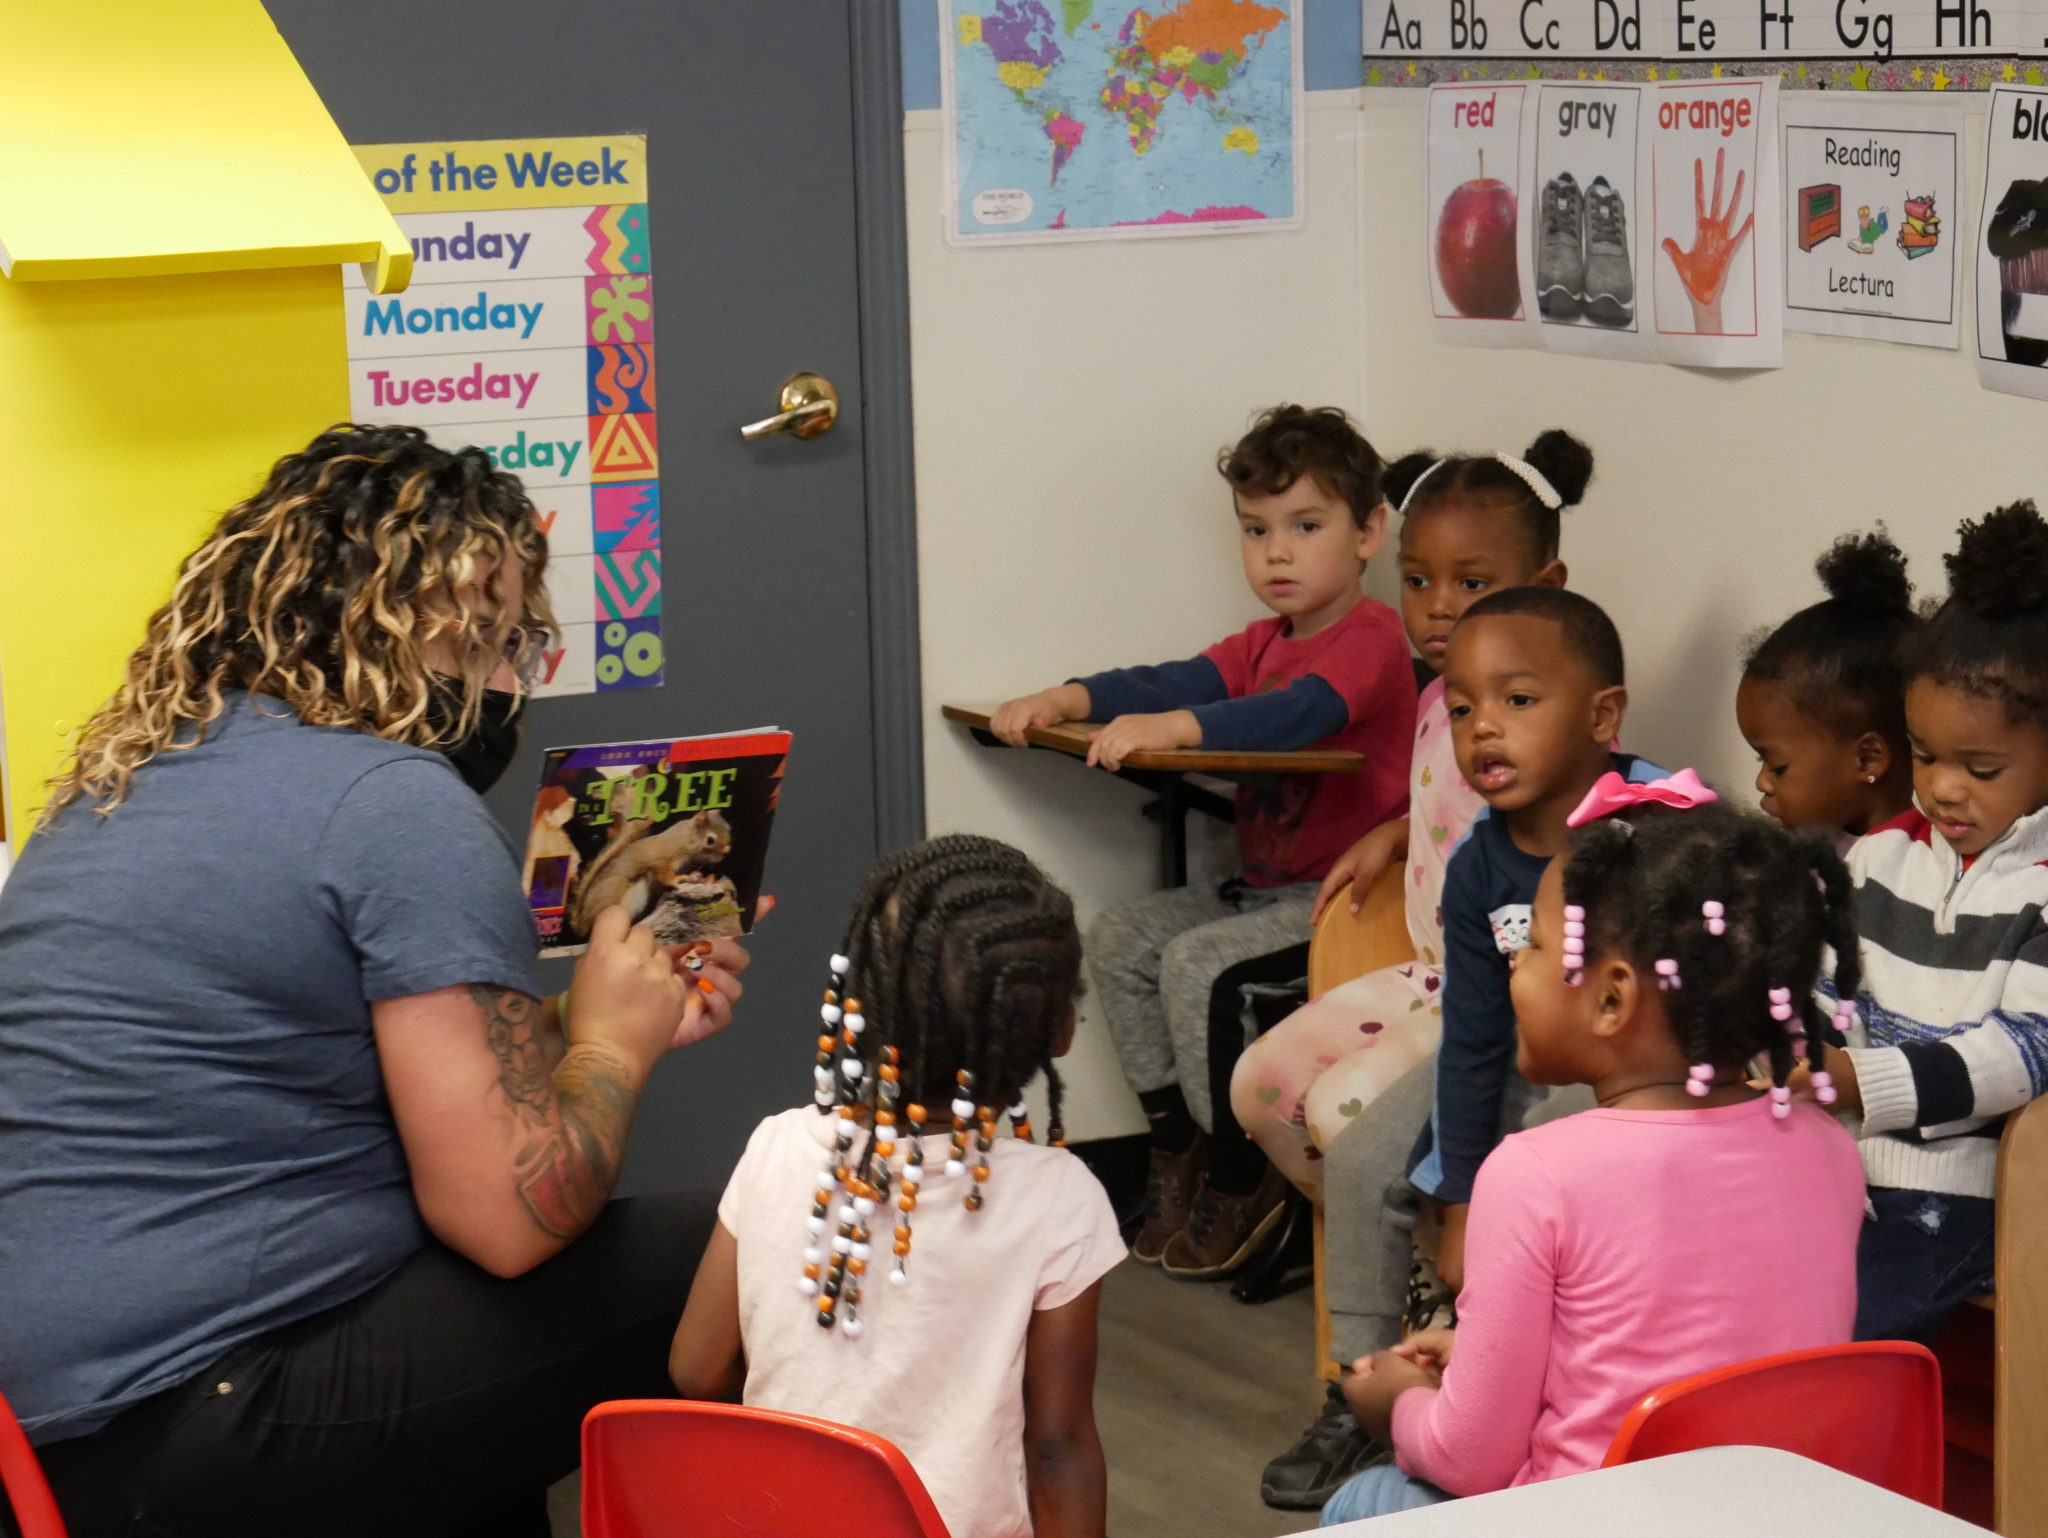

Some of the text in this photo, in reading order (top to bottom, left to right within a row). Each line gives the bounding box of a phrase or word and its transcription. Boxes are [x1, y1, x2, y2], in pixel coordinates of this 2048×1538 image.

[1381, 0, 1421, 49] Aa
[1451, 0, 1487, 50] Bb
[1520, 0, 1559, 50] Cc
[1595, 0, 1640, 51] Dd
[1678, 0, 1715, 51] Ee
[1836, 0, 1893, 62] Gg
[1936, 0, 1991, 47] Hh
[1454, 92, 1497, 127] red
[1559, 101, 1616, 138] gray
[1659, 99, 1751, 136] orange
[374, 147, 628, 194] of the Week
[1826, 138, 1900, 176] Reading
[1829, 269, 1893, 297] Lectura
[364, 292, 543, 339] Monday
[368, 363, 539, 408] Tuesday
[586, 768, 737, 826] TREE
